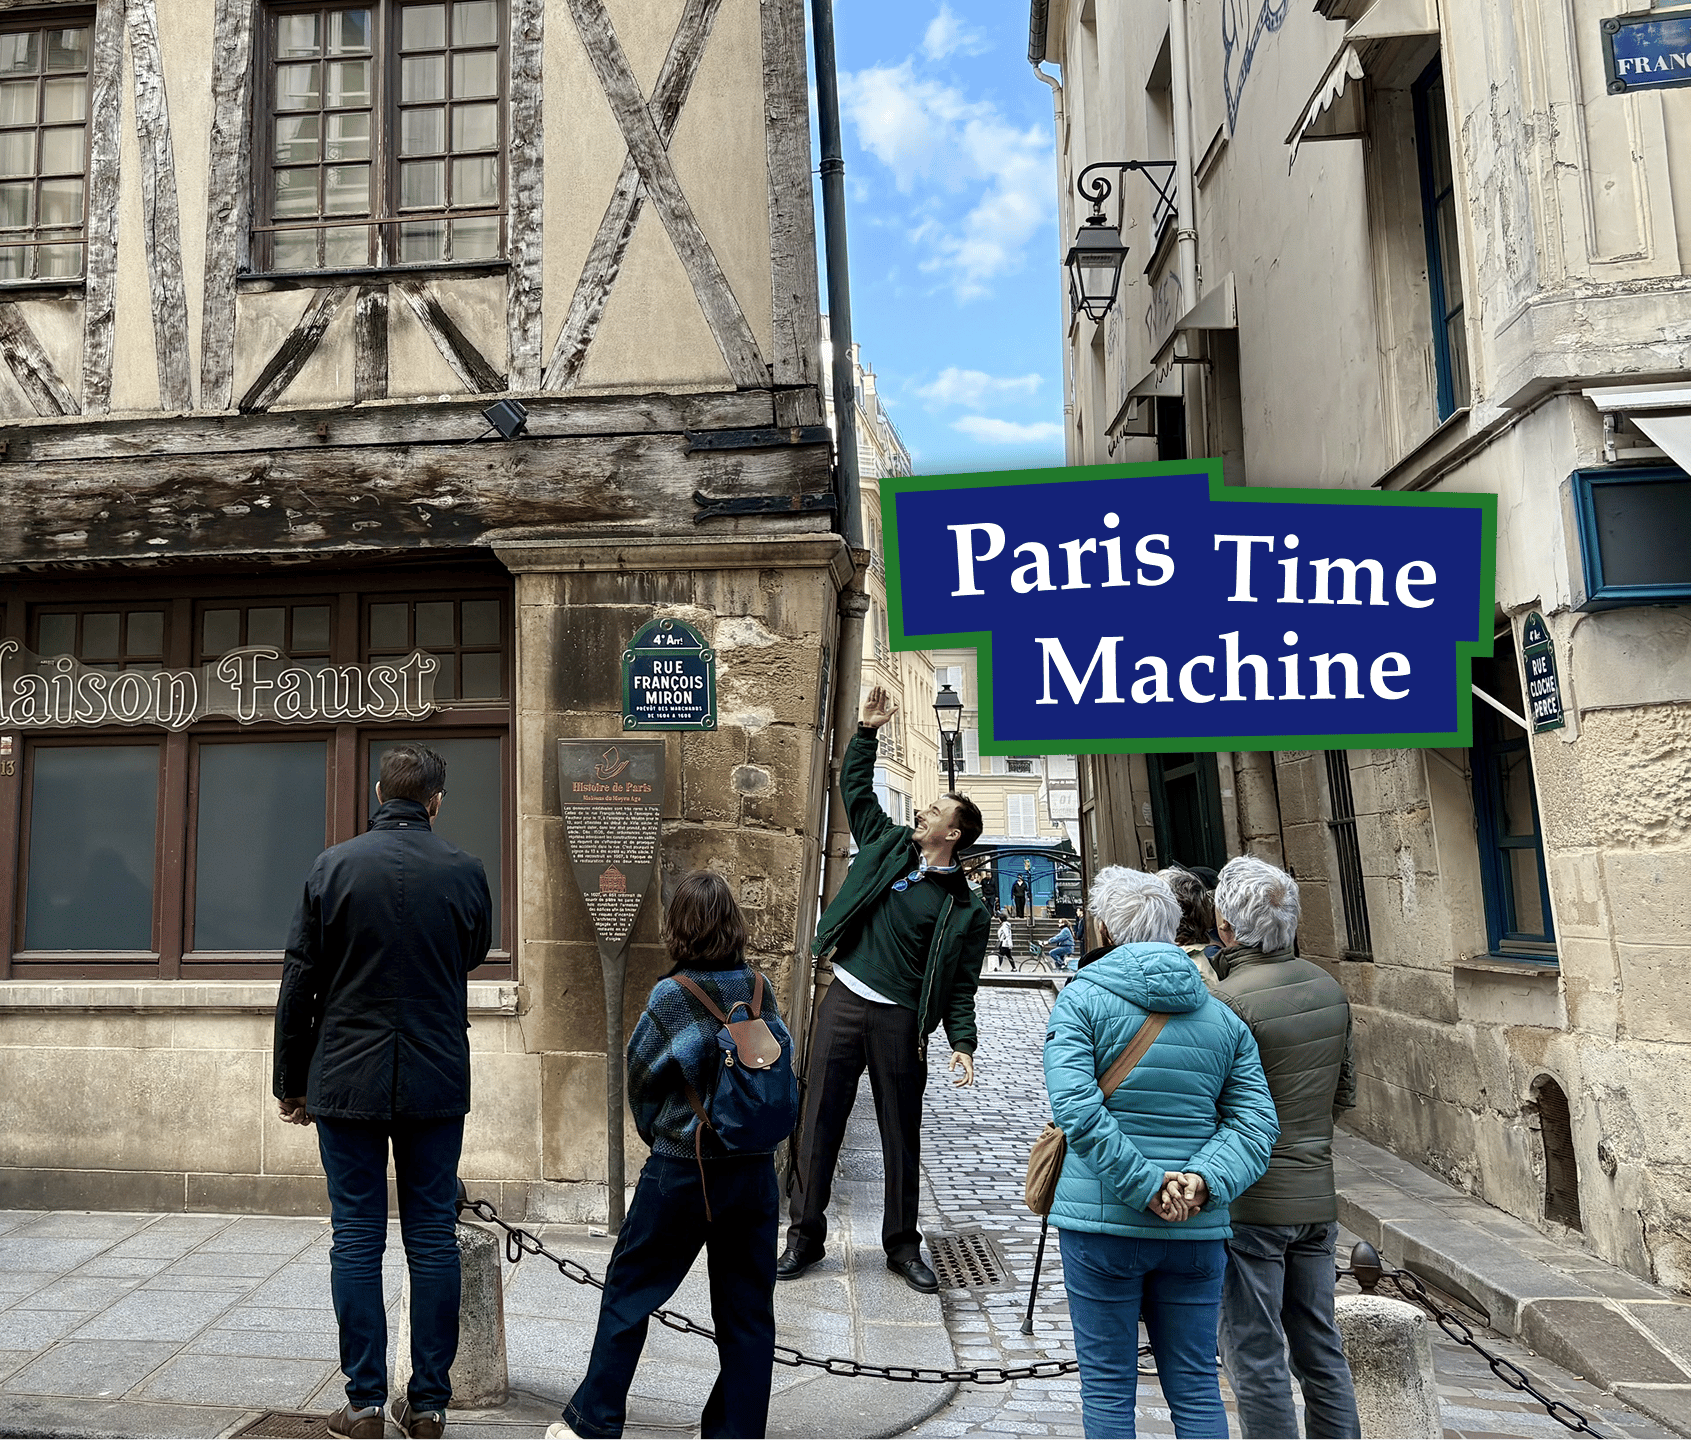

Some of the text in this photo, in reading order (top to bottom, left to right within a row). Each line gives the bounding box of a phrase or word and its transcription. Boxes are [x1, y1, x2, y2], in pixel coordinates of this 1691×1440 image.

[653, 661, 684, 674] RUE
[1531, 656, 1548, 676] RUE
[217, 648, 437, 721] Faust
[634, 675, 704, 691] FRANÇOIS
[1530, 675, 1556, 698] CLOCHE
[645, 691, 693, 705] MIRON
[1533, 696, 1558, 718] PERCE
[0, 760, 15, 776] 13
[572, 782, 652, 792] Histoire de Paris
